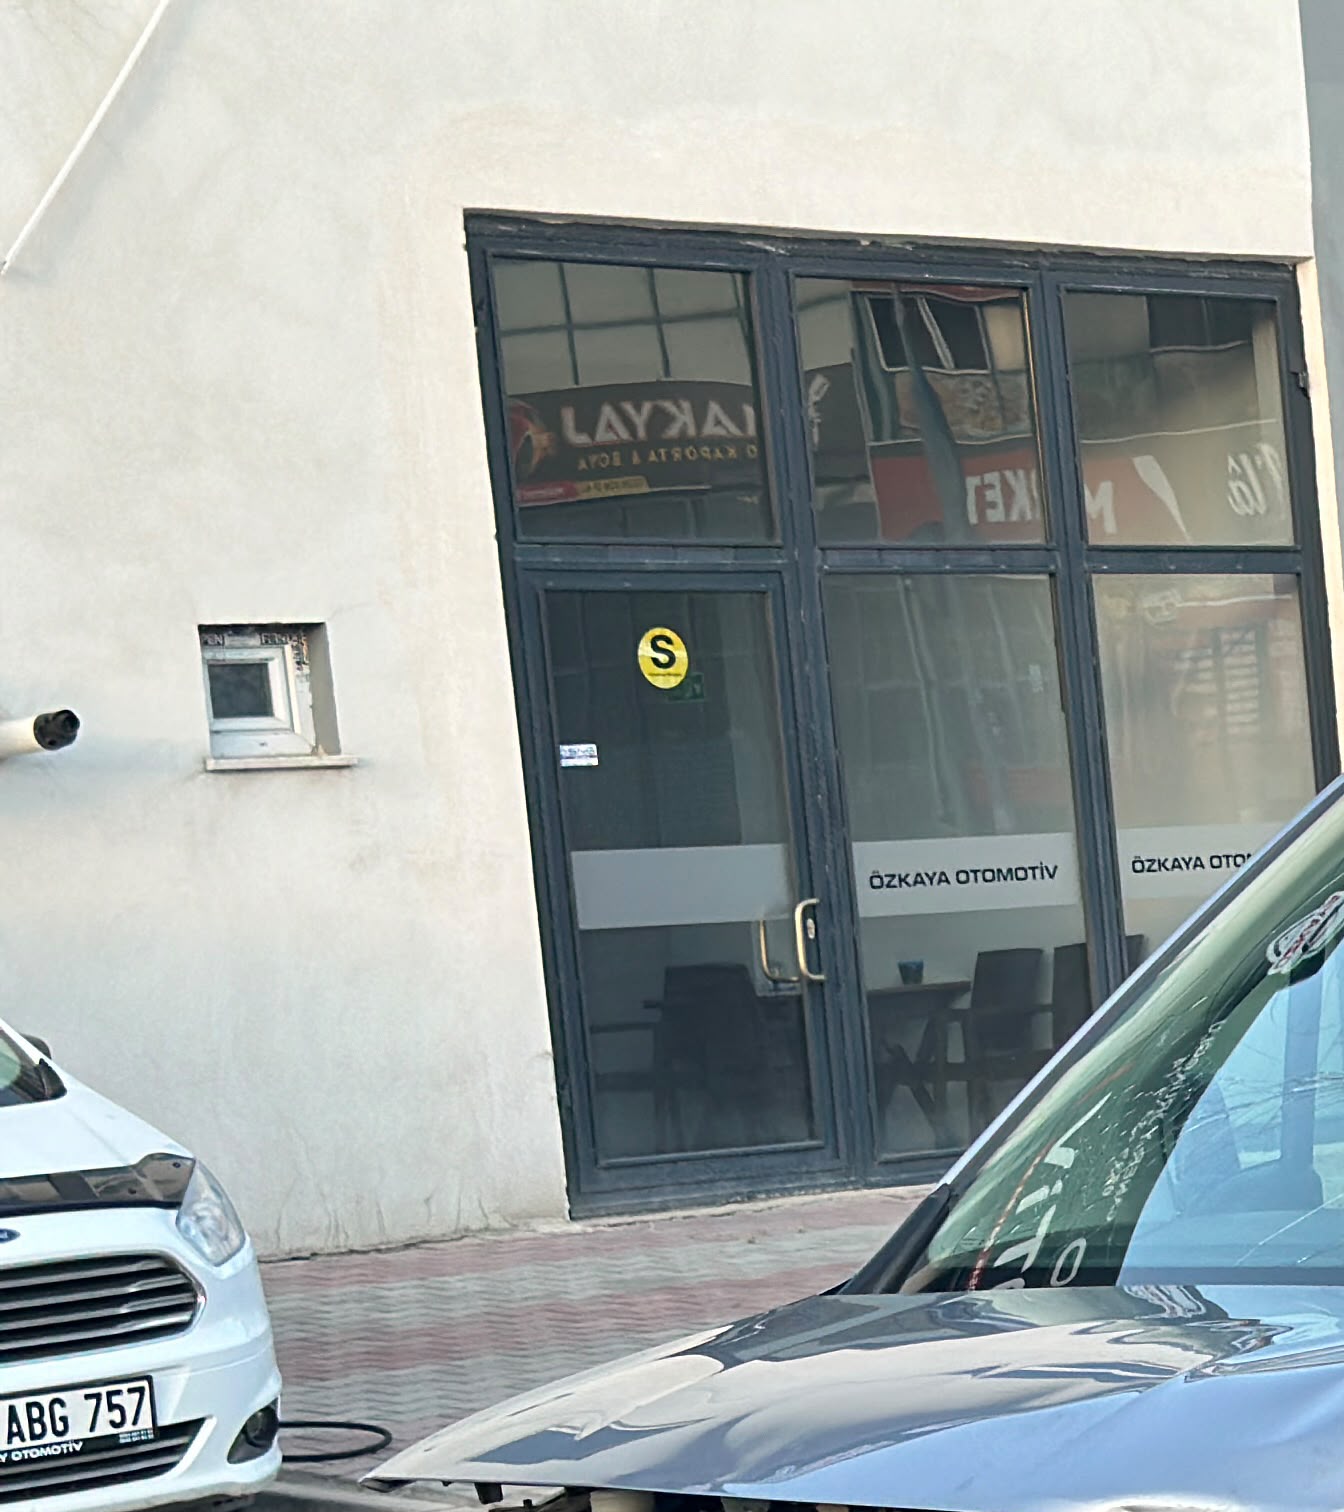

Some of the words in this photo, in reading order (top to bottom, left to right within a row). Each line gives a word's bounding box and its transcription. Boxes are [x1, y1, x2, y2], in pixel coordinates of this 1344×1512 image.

[650, 634, 676, 669] S
[869, 870, 951, 890] ÖZKAYA
[955, 861, 1058, 885] OTOMOTİV
[1132, 856, 1205, 873] ÖZKAYA
[1209, 853, 1252, 869] OTO
[7, 1397, 70, 1445] ABG
[84, 1386, 146, 1433] 757
[11, 1439, 83, 1462] OTOMOTİV
